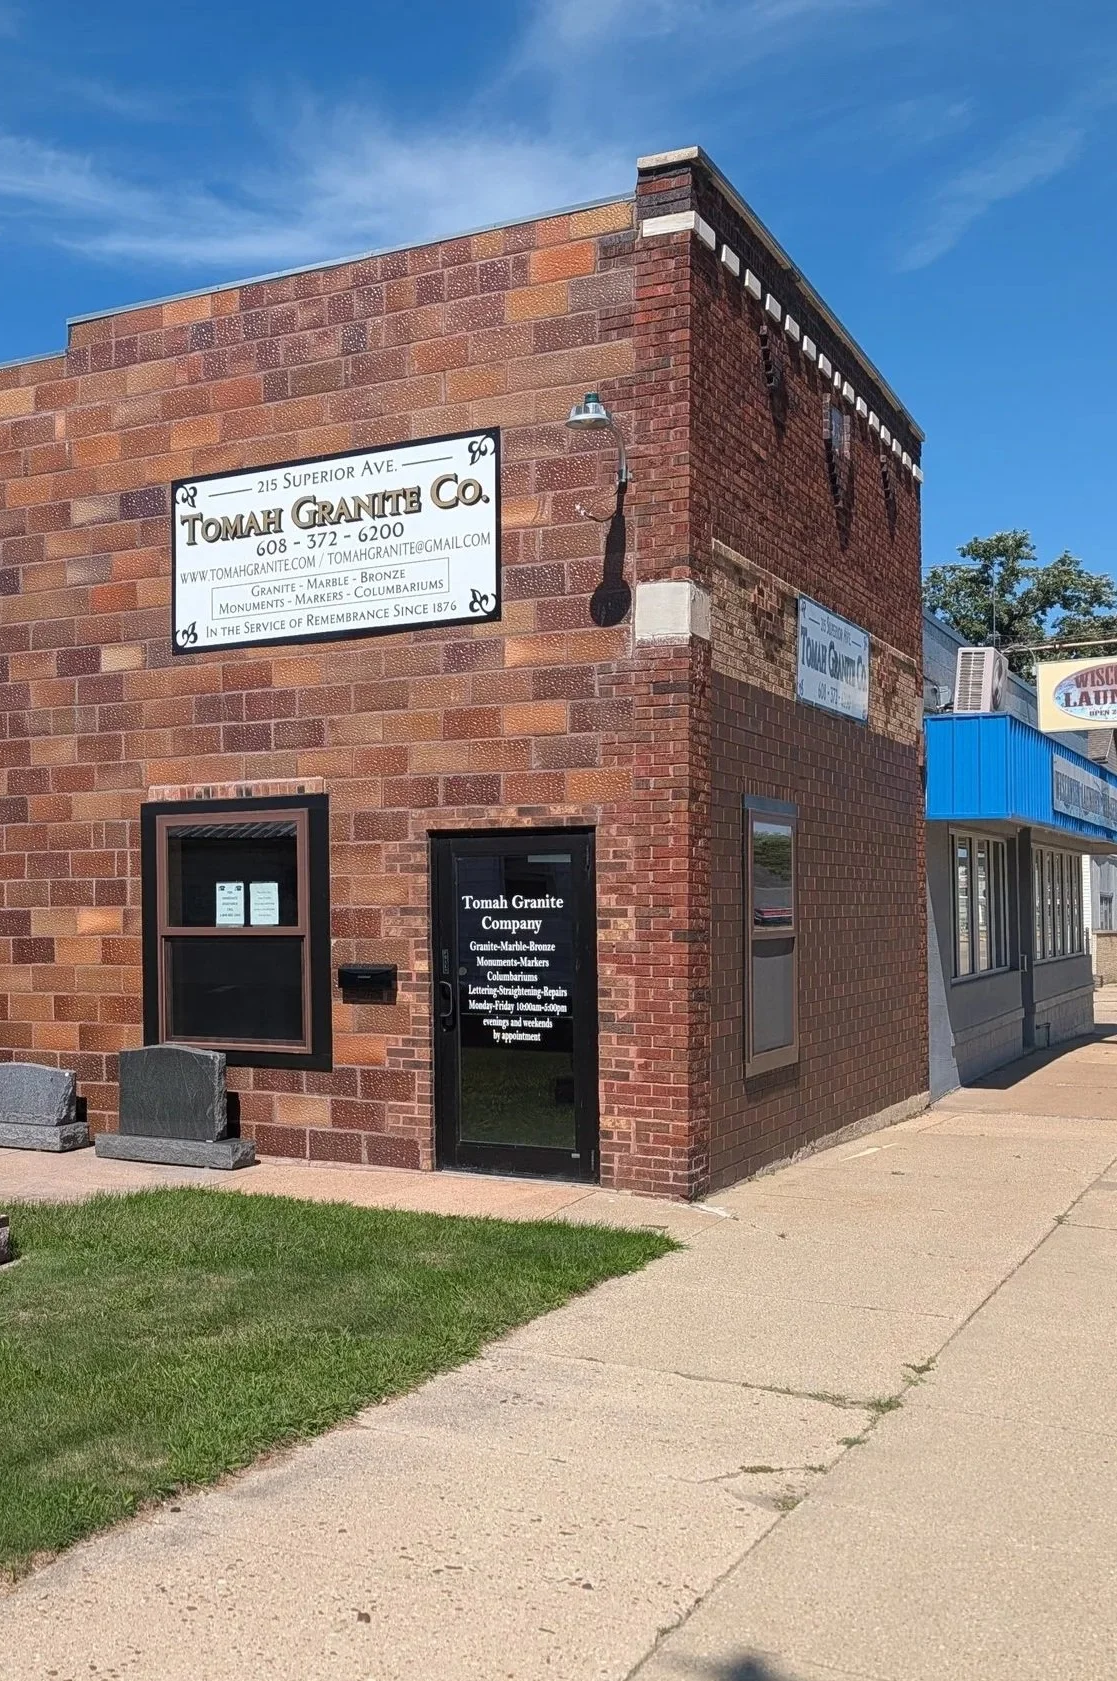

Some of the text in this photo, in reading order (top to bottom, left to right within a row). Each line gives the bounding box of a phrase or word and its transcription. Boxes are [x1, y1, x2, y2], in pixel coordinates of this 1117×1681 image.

[257, 459, 398, 493] 215 SUPERIOR AVE.
[180, 472, 490, 546] TOMAH GRANITE CO.
[256, 538, 287, 557] 608
[307, 531, 338, 549] 372
[358, 521, 404, 543] 6200
[180, 554, 316, 584] WWW.TOMAHGRANITE.COM
[327, 531, 491, 566] TOMAHGRANITE@GMAIL.COM
[251, 582, 296, 597] GRANITE
[306, 576, 349, 591] MARBLE
[360, 569, 406, 584] BRONZE
[219, 598, 285, 615] MONUMENTS
[294, 591, 344, 606] MARKERS
[354, 579, 444, 599] COLUMBARIUMS
[206, 600, 457, 639] IN THE SERVICE OF REMEMBRANCE SINCE 1876
[461, 893, 564, 909] Tomah Granite
[481, 915, 543, 934] Company
[469, 940, 556, 952] Granite-Marble-Bronze
[476, 956, 550, 967] Monuments-Markers
[486, 970, 538, 982] Columbariums
[468, 984, 568, 1000] Lettering-Straightening-Repairs
[468, 999, 515, 1014] Monday-Friday
[483, 1015, 553, 1030] evenings and weekends
[492, 1029, 541, 1043] by appointment
